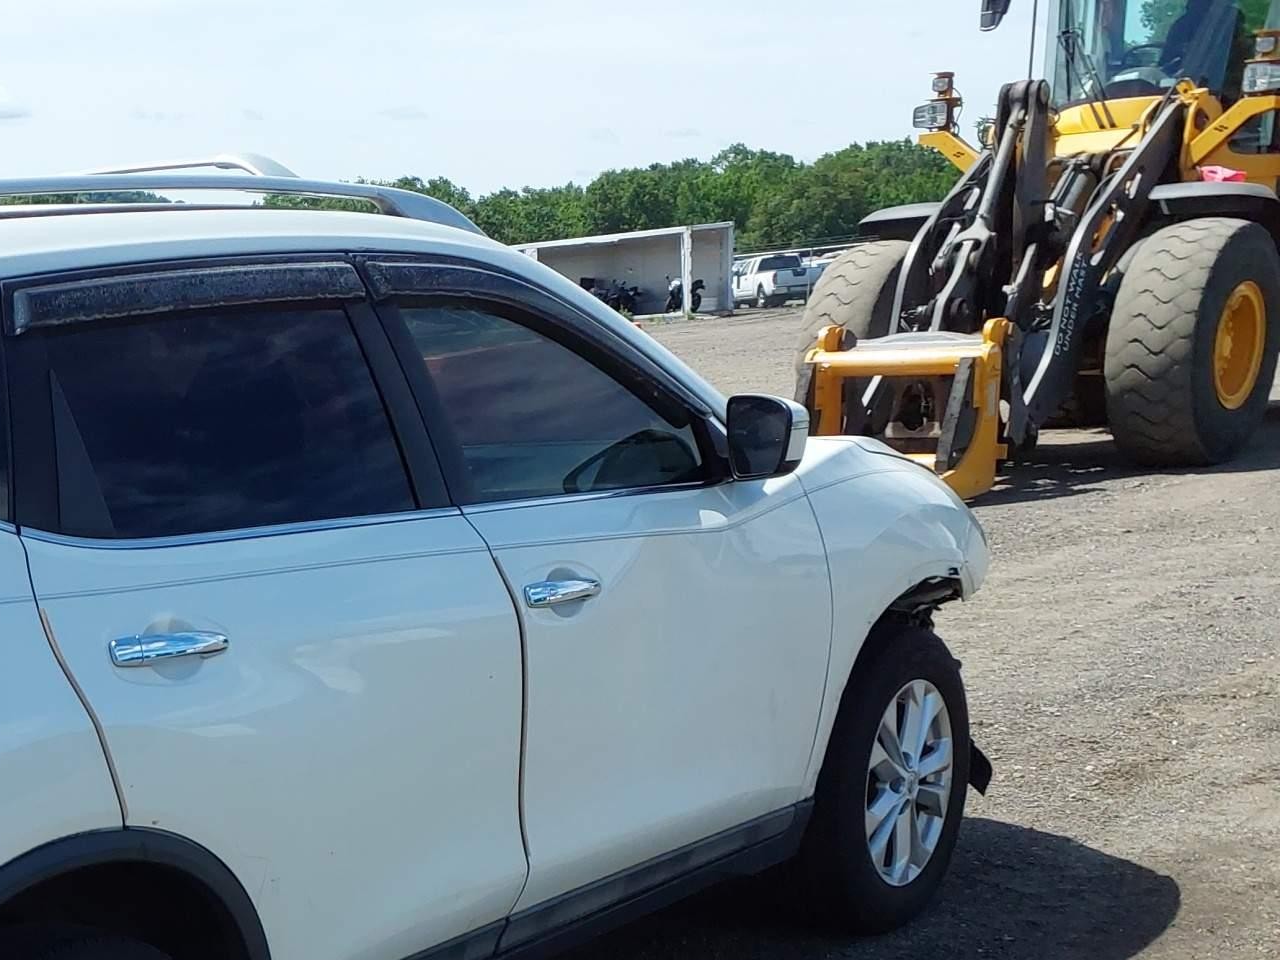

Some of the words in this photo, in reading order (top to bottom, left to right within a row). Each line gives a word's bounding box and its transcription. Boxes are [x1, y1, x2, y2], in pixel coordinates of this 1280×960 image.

[1054, 332, 1064, 356] DO
[1060, 296, 1072, 329] NOT
[1067, 251, 1084, 292] WALK
[1062, 302, 1080, 352] UNDER
[1074, 258, 1088, 299] MAST
